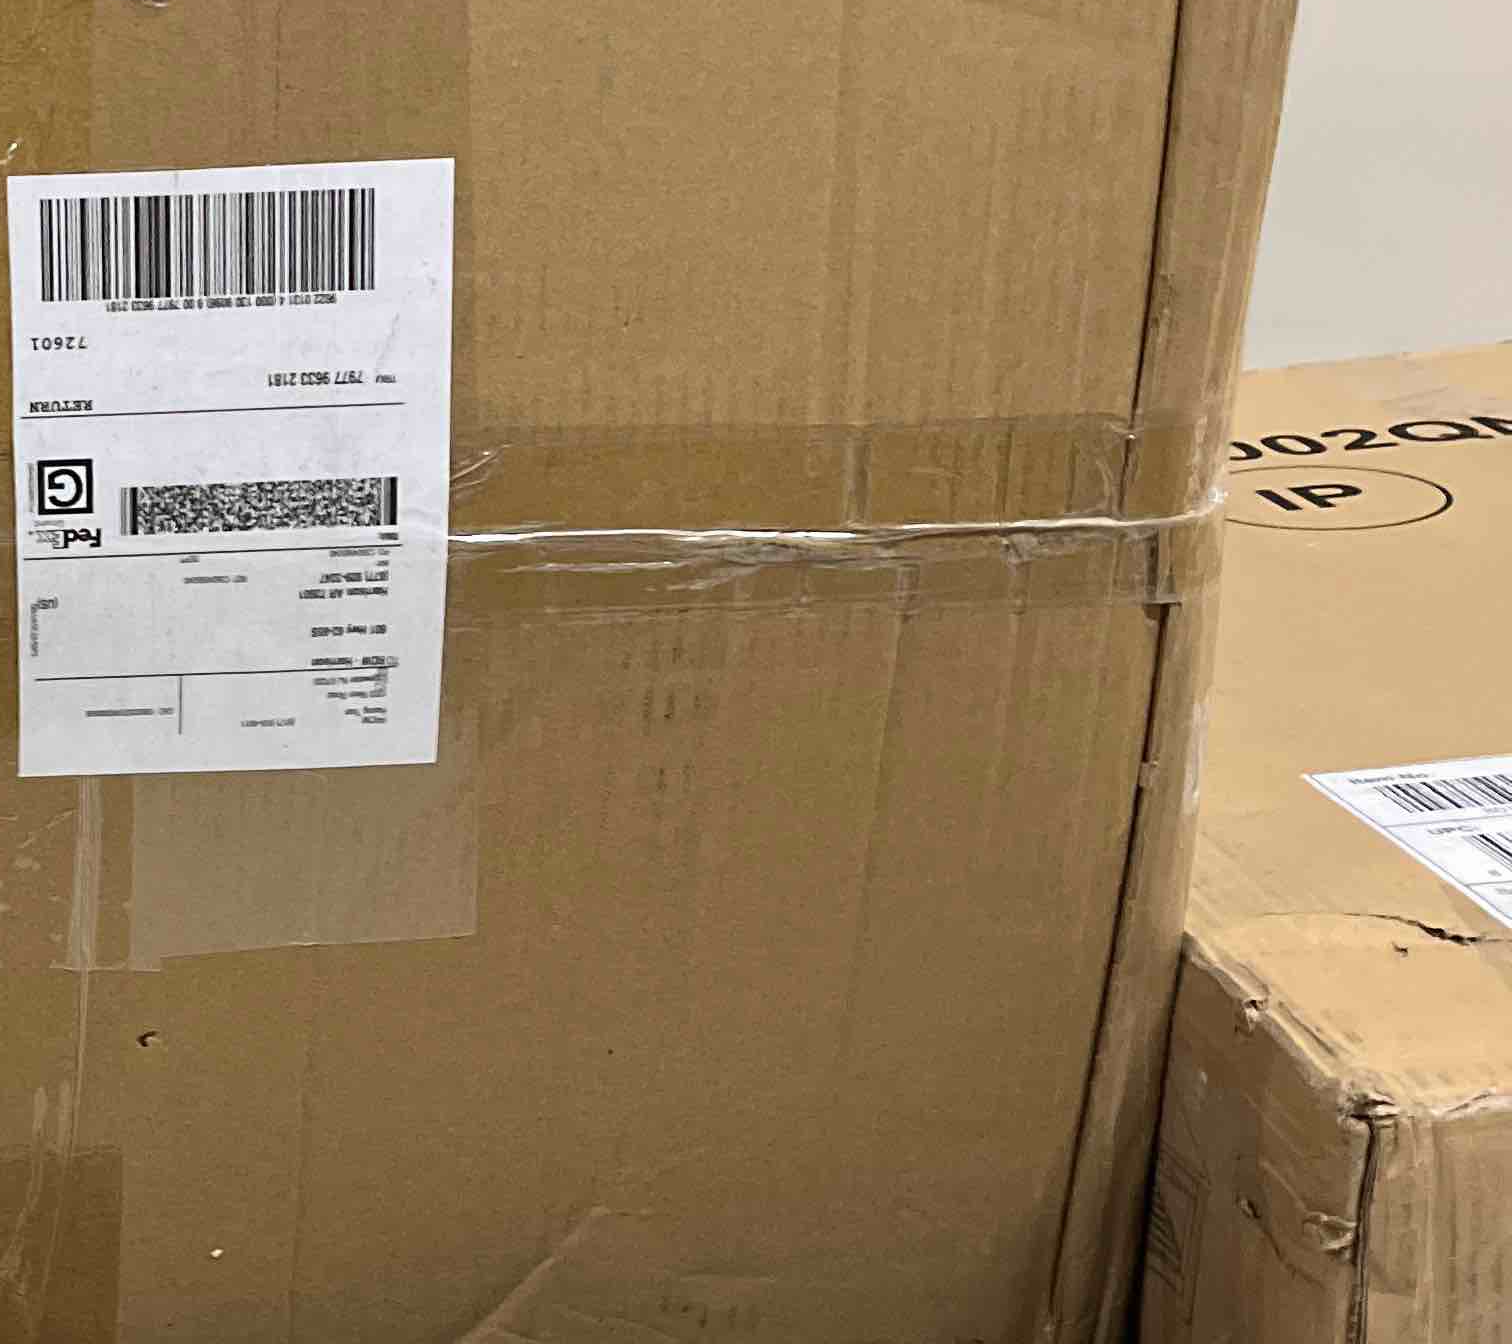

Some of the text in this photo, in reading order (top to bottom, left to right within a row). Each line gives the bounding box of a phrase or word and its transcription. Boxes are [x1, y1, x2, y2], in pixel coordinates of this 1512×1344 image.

[30, 336, 87, 350] 72601
[268, 373, 297, 387] 2181
[300, 372, 330, 385] 9633
[334, 371, 363, 384] 7977
[29, 400, 93, 413] RETURN
[47, 469, 83, 508] G
[1256, 484, 1362, 511] IP
[34, 528, 102, 549] FedEx
